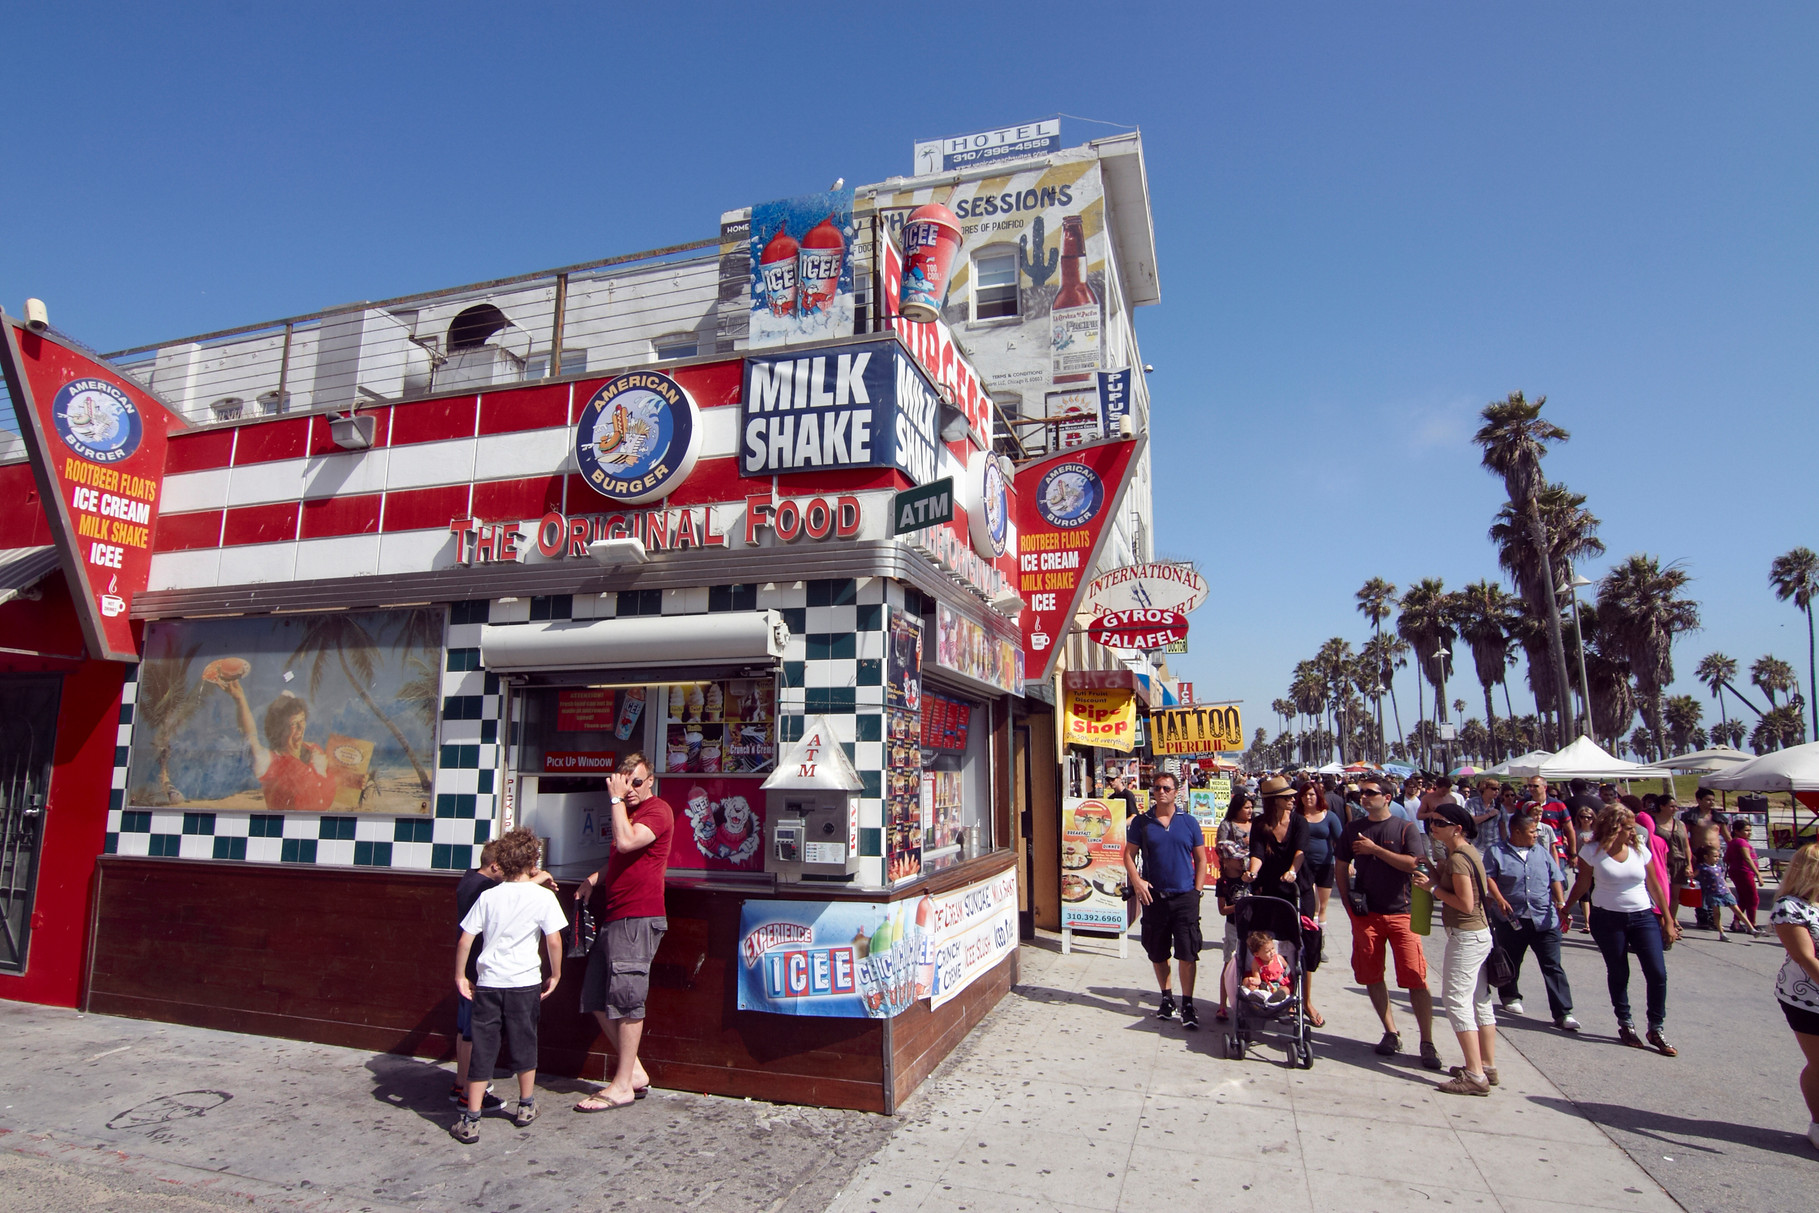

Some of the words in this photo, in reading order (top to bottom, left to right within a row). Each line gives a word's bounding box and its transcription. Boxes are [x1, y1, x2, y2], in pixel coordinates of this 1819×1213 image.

[951, 123, 1050, 152] HOTEL
[953, 138, 1050, 163] 310/396-4559
[955, 184, 1073, 219] SESSIONS
[904, 223, 939, 247] ICEE
[980, 223, 990, 232] OF
[992, 219, 1024, 232] PACIFICO
[765, 263, 798, 292] ICE
[801, 254, 841, 279] ICEE
[927, 264, 937, 272] TOO
[593, 375, 681, 413] AMERICAN
[749, 352, 872, 413] MILK
[68, 381, 135, 414] AMERICAN
[896, 353, 936, 448] MILK
[65, 434, 125, 461] BURGER
[746, 409, 872, 472] SHAKE
[64, 457, 119, 492] ROOTBEER
[119, 474, 156, 501] FLOATS
[591, 464, 669, 494] BURGER
[1045, 464, 1095, 485] AMERICAN
[73, 486, 99, 513] ICE
[100, 492, 150, 525] CREAM
[900, 492, 948, 528] ATM
[1047, 511, 1092, 527] BURGER
[78, 513, 109, 541] MILK
[110, 520, 149, 549] SHAKE
[450, 517, 523, 563] THE
[537, 506, 728, 557] ORIGINAL
[744, 494, 863, 546] FOOD
[1021, 532, 1060, 551] ROOTBEER
[1061, 530, 1090, 549] FLOATS
[90, 541, 124, 569] ICEE
[1021, 553, 1039, 571] ICE
[1040, 551, 1079, 571] CREAM
[1021, 573, 1043, 591] MILK
[1045, 571, 1074, 589] SHAKE
[1088, 564, 1202, 599] INTERNATIONAL
[1031, 594, 1056, 611] ICEE
[1102, 609, 1175, 627] GYROS
[1100, 629, 1179, 649] FALAFEL
[1073, 719, 1128, 735] Shop
[1151, 707, 1241, 749] TATTOO
[730, 743, 750, 754] Crunch
[797, 734, 821, 777] ATM
[1100, 737, 1130, 750] everything
[1166, 739, 1226, 754] PIERCING
[546, 756, 564, 767] PICK
[565, 756, 576, 767] UP
[578, 756, 613, 767] WINDOW
[583, 813, 594, 834] A
[964, 886, 992, 917] SUNDAE
[1067, 912, 1122, 923] 310.392.6960
[744, 922, 812, 966] EXPERIENCE
[937, 940, 961, 970] CRUNCH
[772, 951, 853, 993] ICEE
